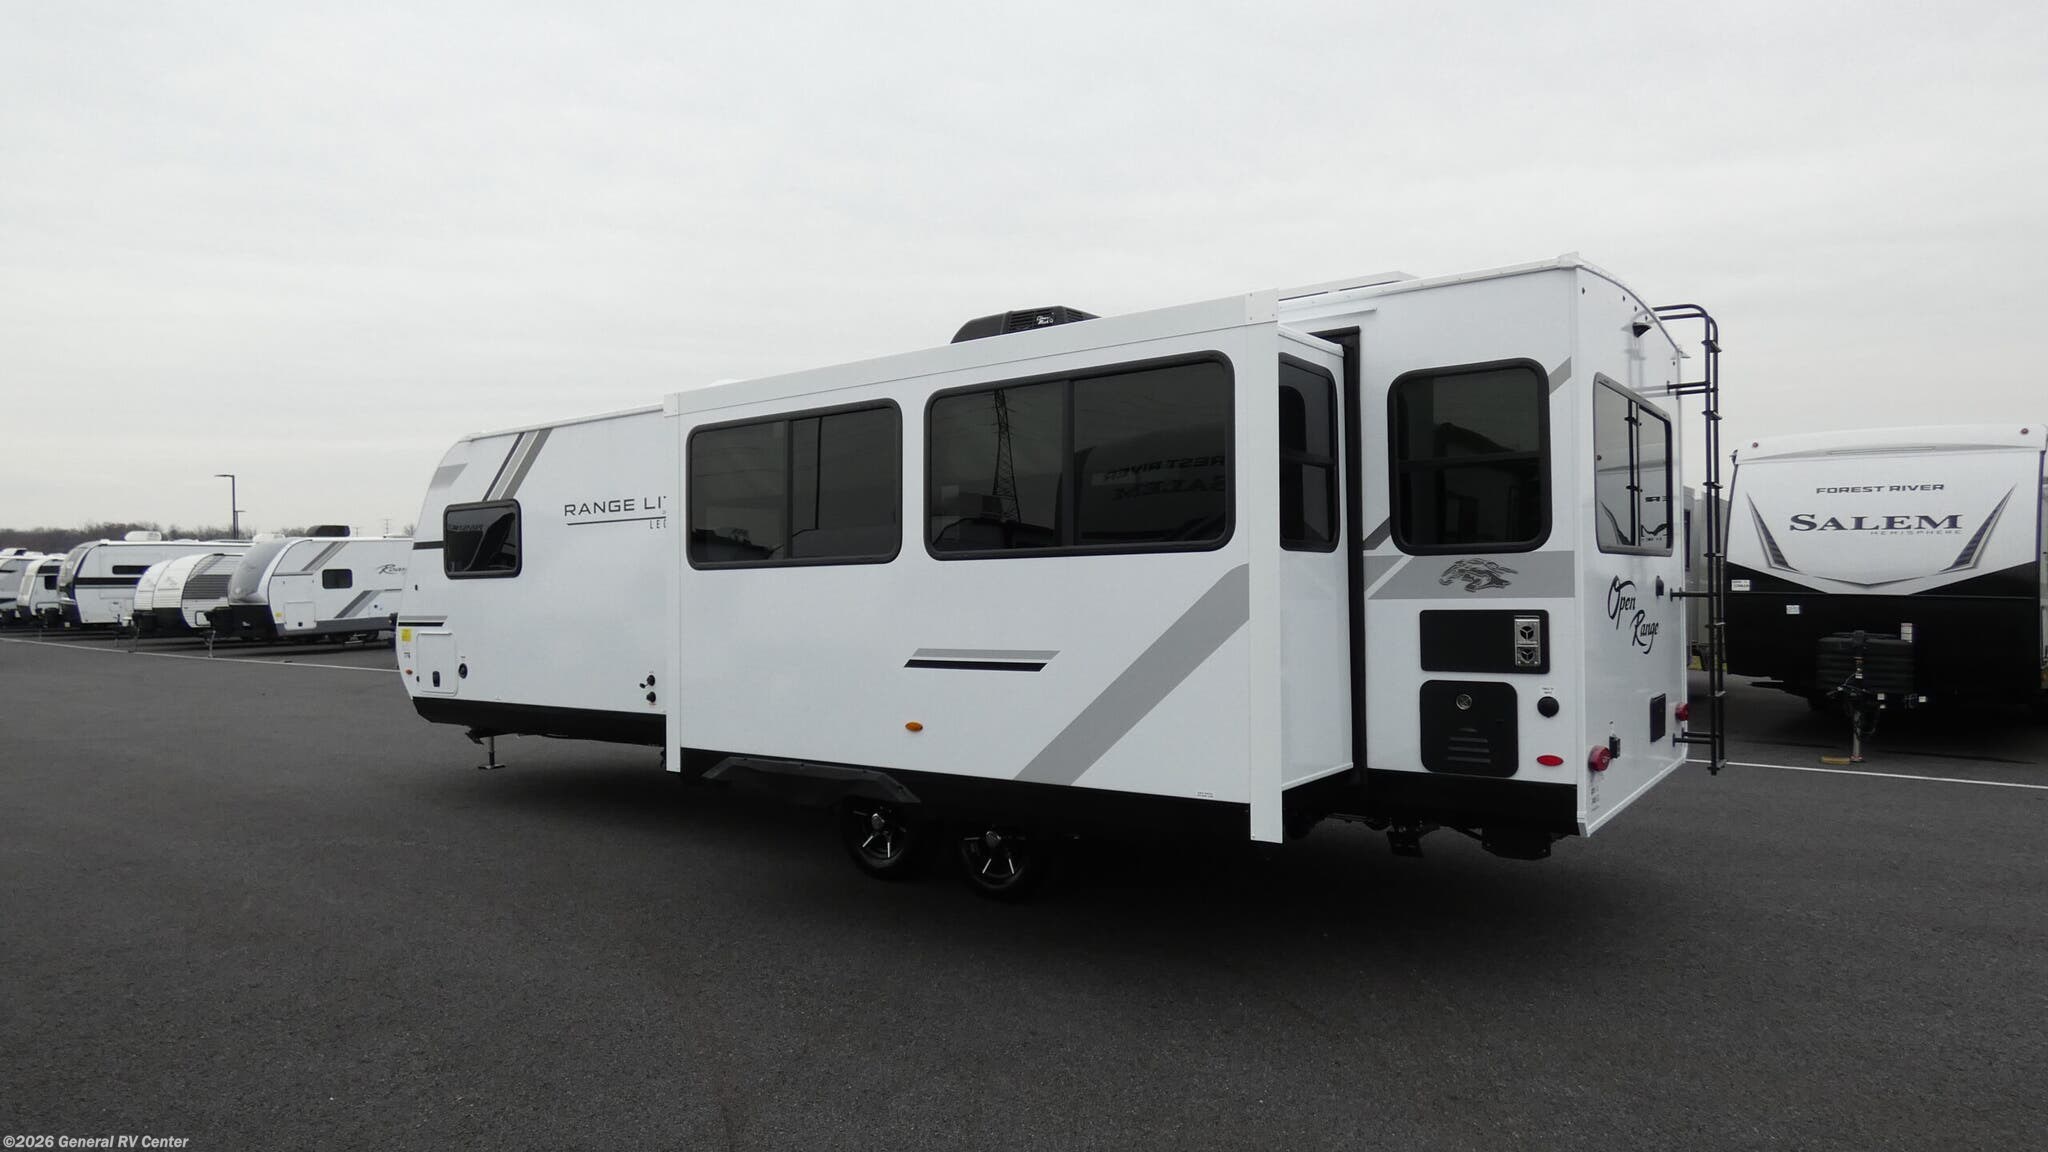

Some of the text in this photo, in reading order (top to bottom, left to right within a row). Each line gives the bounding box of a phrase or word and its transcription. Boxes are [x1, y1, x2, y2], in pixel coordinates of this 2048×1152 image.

[1816, 483, 1945, 495] FOREST RIVER
[564, 495, 667, 517] RANGE LI
[1789, 513, 1964, 532] SALEM
[1607, 574, 1637, 631] Open
[1628, 609, 1660, 655] Range
